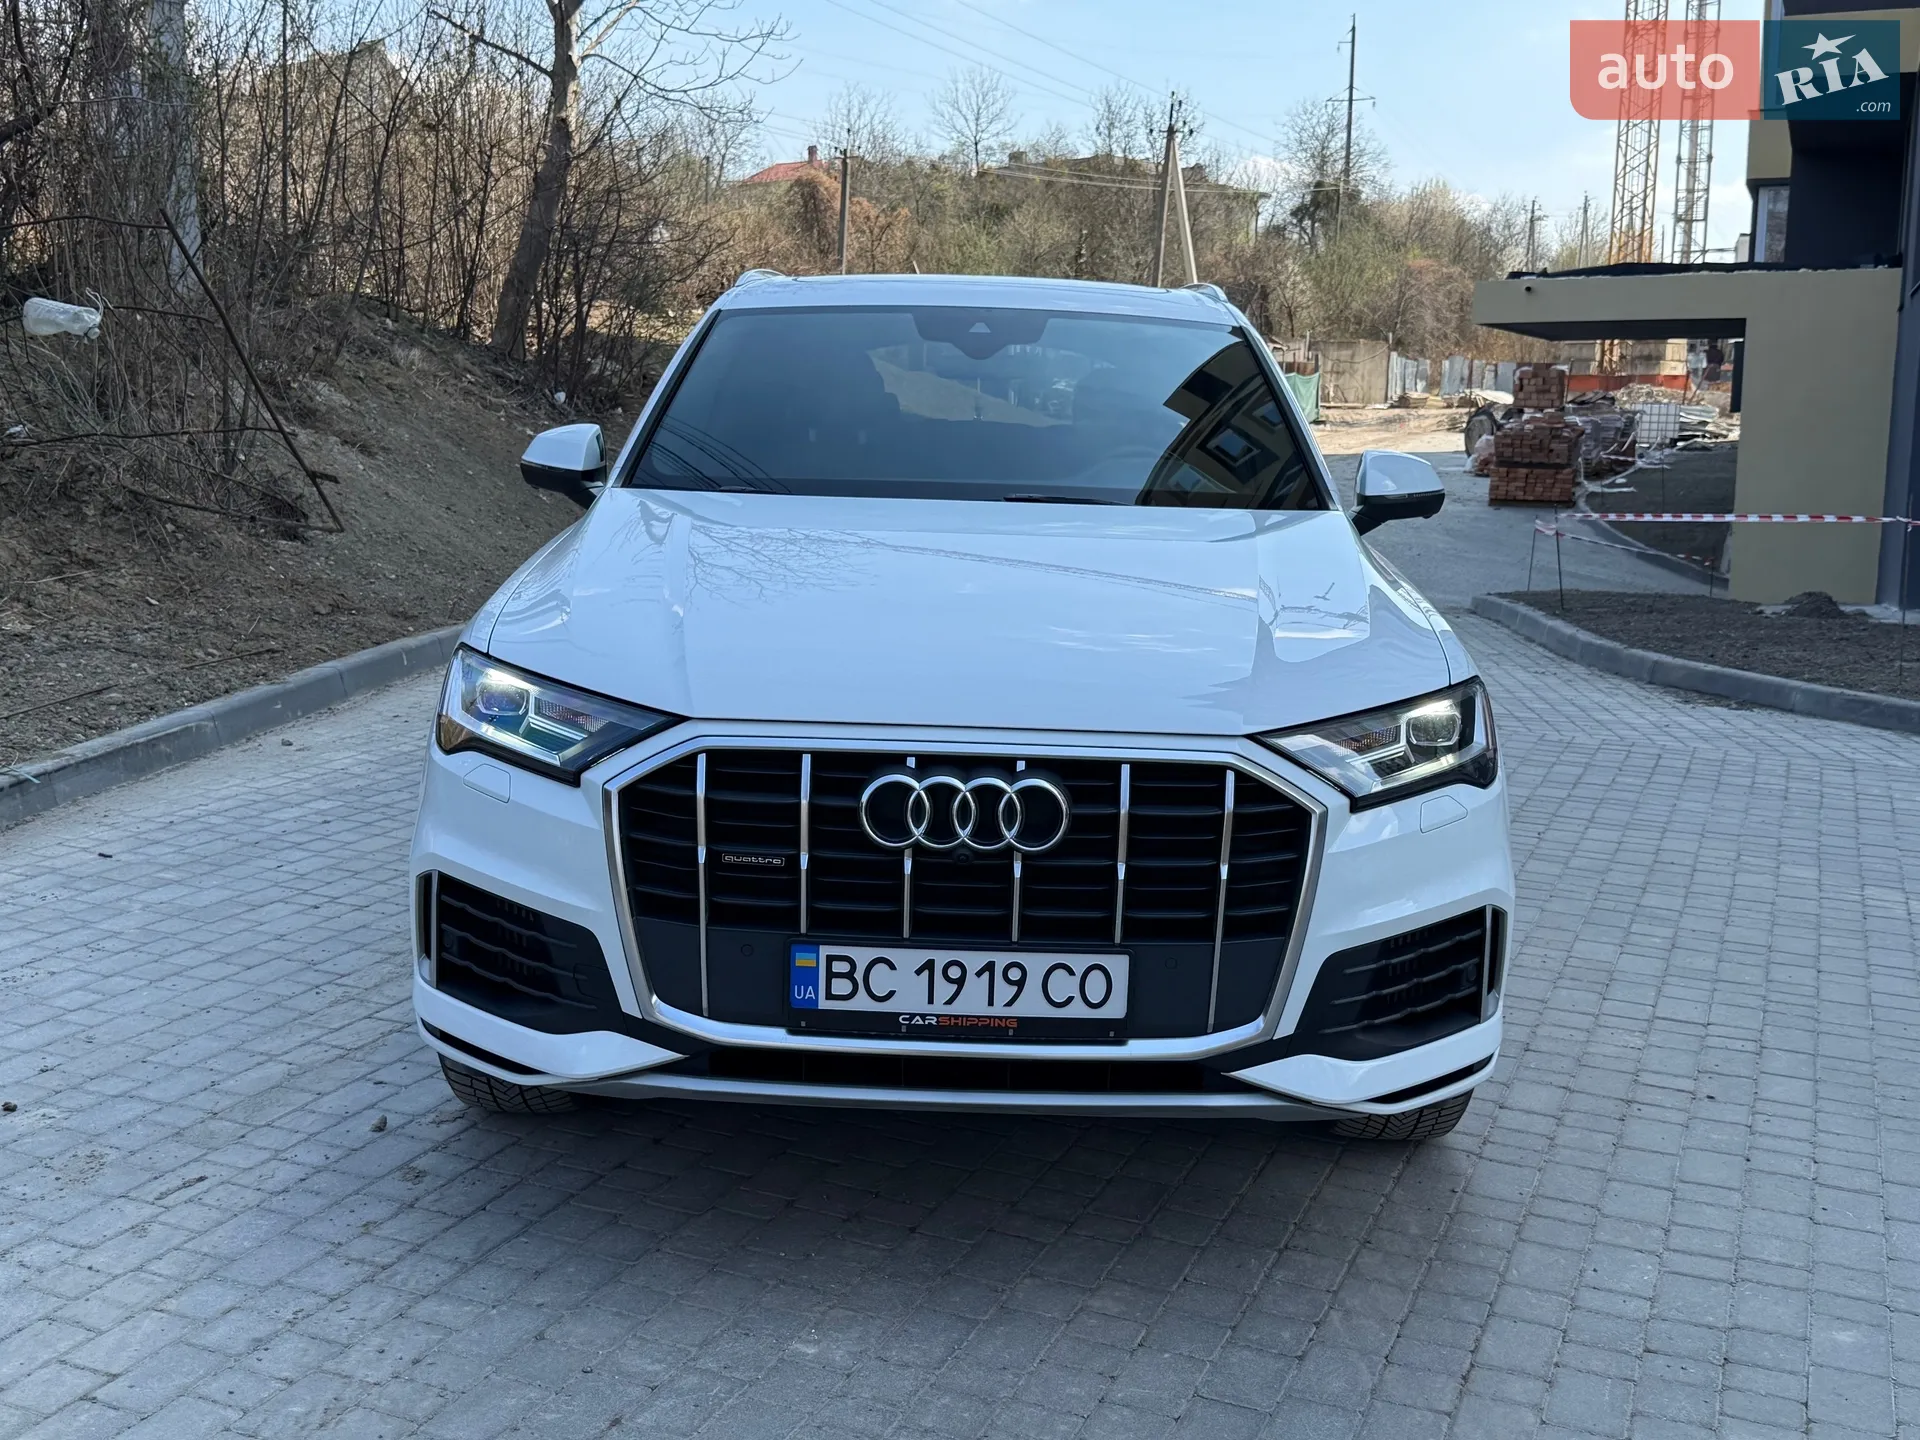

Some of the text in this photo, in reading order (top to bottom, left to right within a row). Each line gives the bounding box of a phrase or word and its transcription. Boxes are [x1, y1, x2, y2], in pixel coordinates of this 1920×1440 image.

[724, 855, 781, 864] quattro
[824, 954, 1113, 1010] BC 1919 CO
[794, 984, 816, 1000] UA
[898, 1014, 1018, 1028] CARSHIPPING
